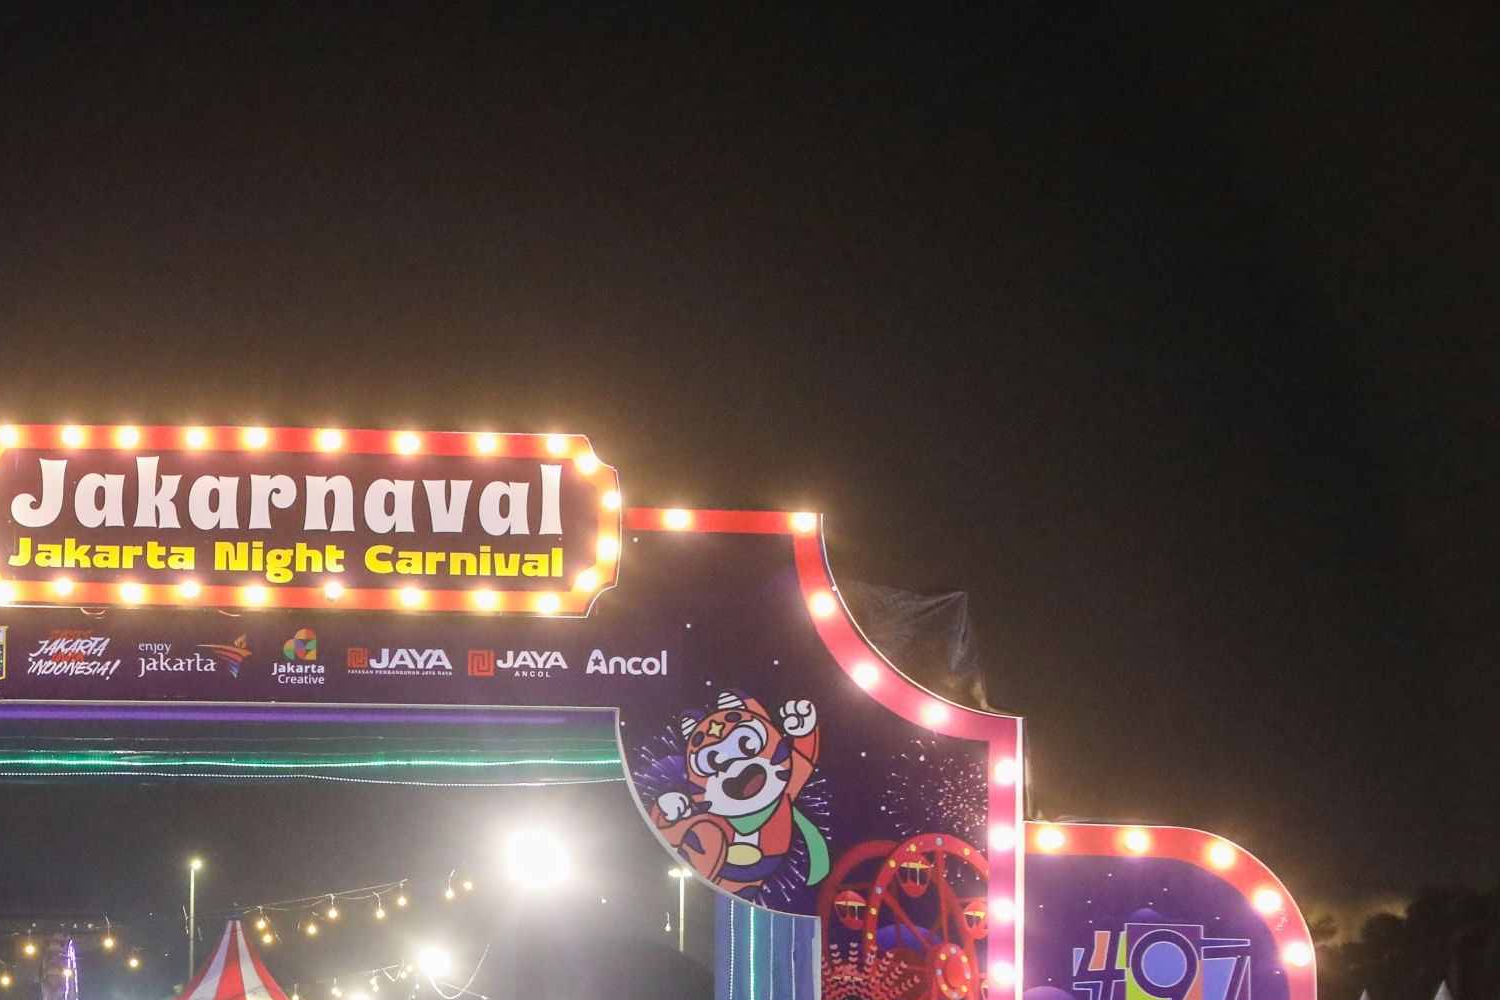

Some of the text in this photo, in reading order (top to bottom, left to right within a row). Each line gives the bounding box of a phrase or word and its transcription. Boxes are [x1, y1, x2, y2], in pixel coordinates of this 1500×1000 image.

[10, 456, 563, 536] Jakarnaval
[7, 537, 563, 583] Jakarta Night Carnival
[28, 636, 111, 657] JAKARTA
[138, 643, 171, 655] enjoy
[138, 652, 217, 678] jakarta
[271, 662, 325, 676] Jakarta
[369, 648, 453, 669] JAYA
[496, 650, 568, 669] JAYA
[585, 649, 668, 675] Ancol
[277, 674, 325, 685] Creative
[514, 670, 551, 678] ANCOL
